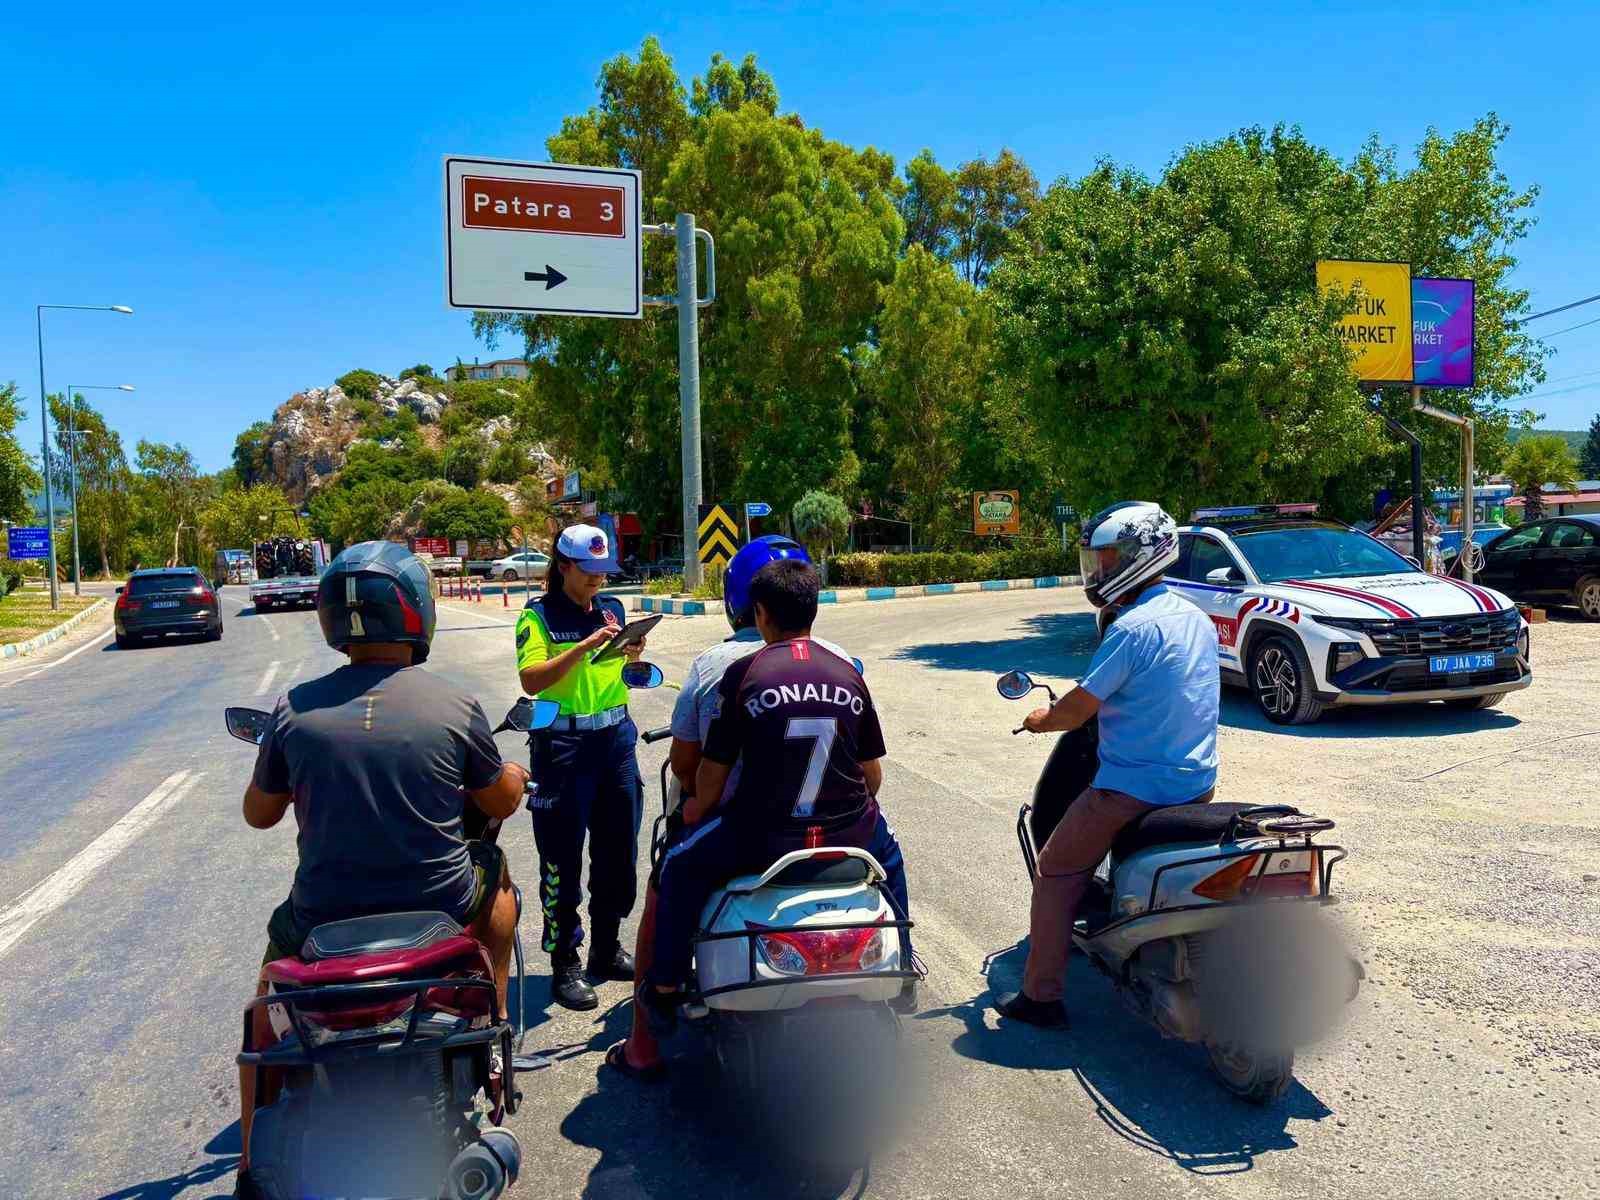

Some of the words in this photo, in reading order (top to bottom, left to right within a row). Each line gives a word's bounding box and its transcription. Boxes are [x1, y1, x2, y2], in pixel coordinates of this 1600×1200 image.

[473, 192, 572, 220] Patara
[599, 202, 615, 222] 3
[1334, 325, 1396, 344] MARKET
[1414, 320, 1436, 332] FUK
[1414, 334, 1443, 345] RKET
[1436, 659, 1448, 671] 07
[1453, 656, 1470, 670] JAA
[1475, 655, 1493, 667] 736
[744, 683, 865, 719] RONALDO
[784, 717, 838, 818] 7
